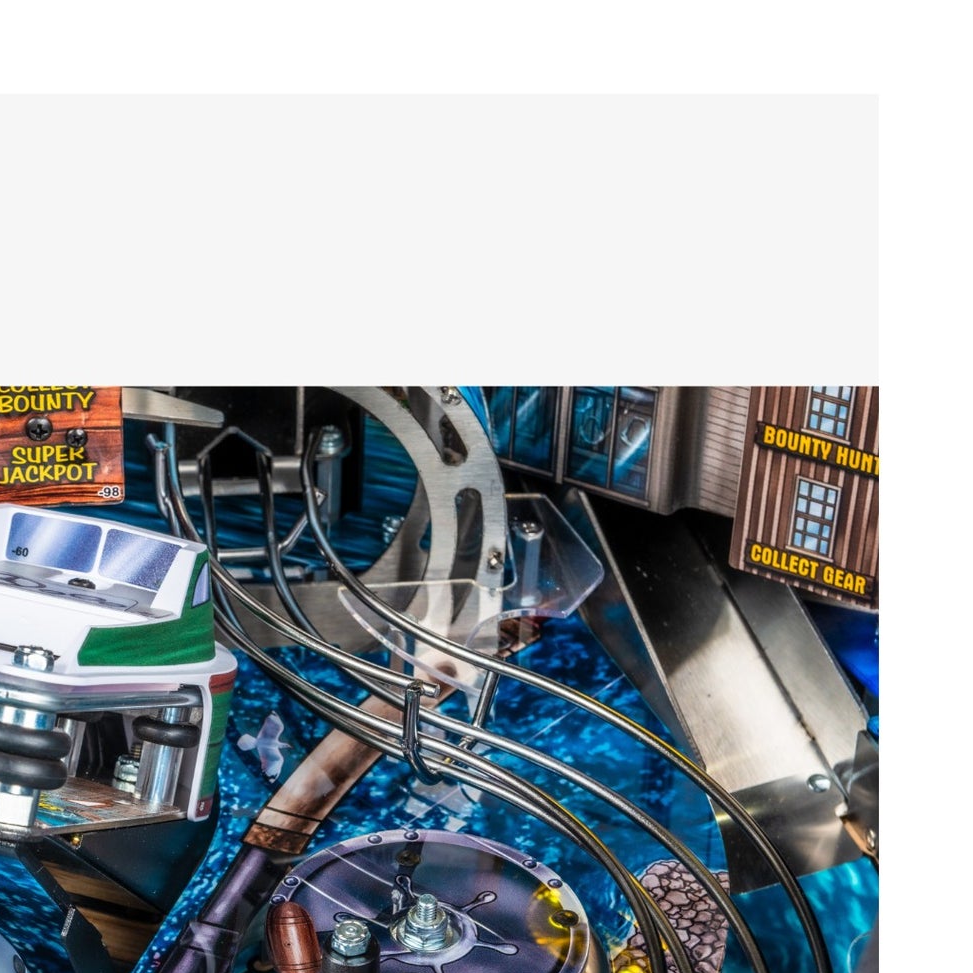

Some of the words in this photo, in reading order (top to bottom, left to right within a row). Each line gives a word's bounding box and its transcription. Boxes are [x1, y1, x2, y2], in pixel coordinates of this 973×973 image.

[763, 425, 832, 461] BOUNTY
[11, 445, 85, 465] SUPER
[97, 485, 121, 498] -98
[11, 546, 29, 557] -60
[750, 543, 819, 580] COLLECT
[822, 566, 867, 595] GEAR
